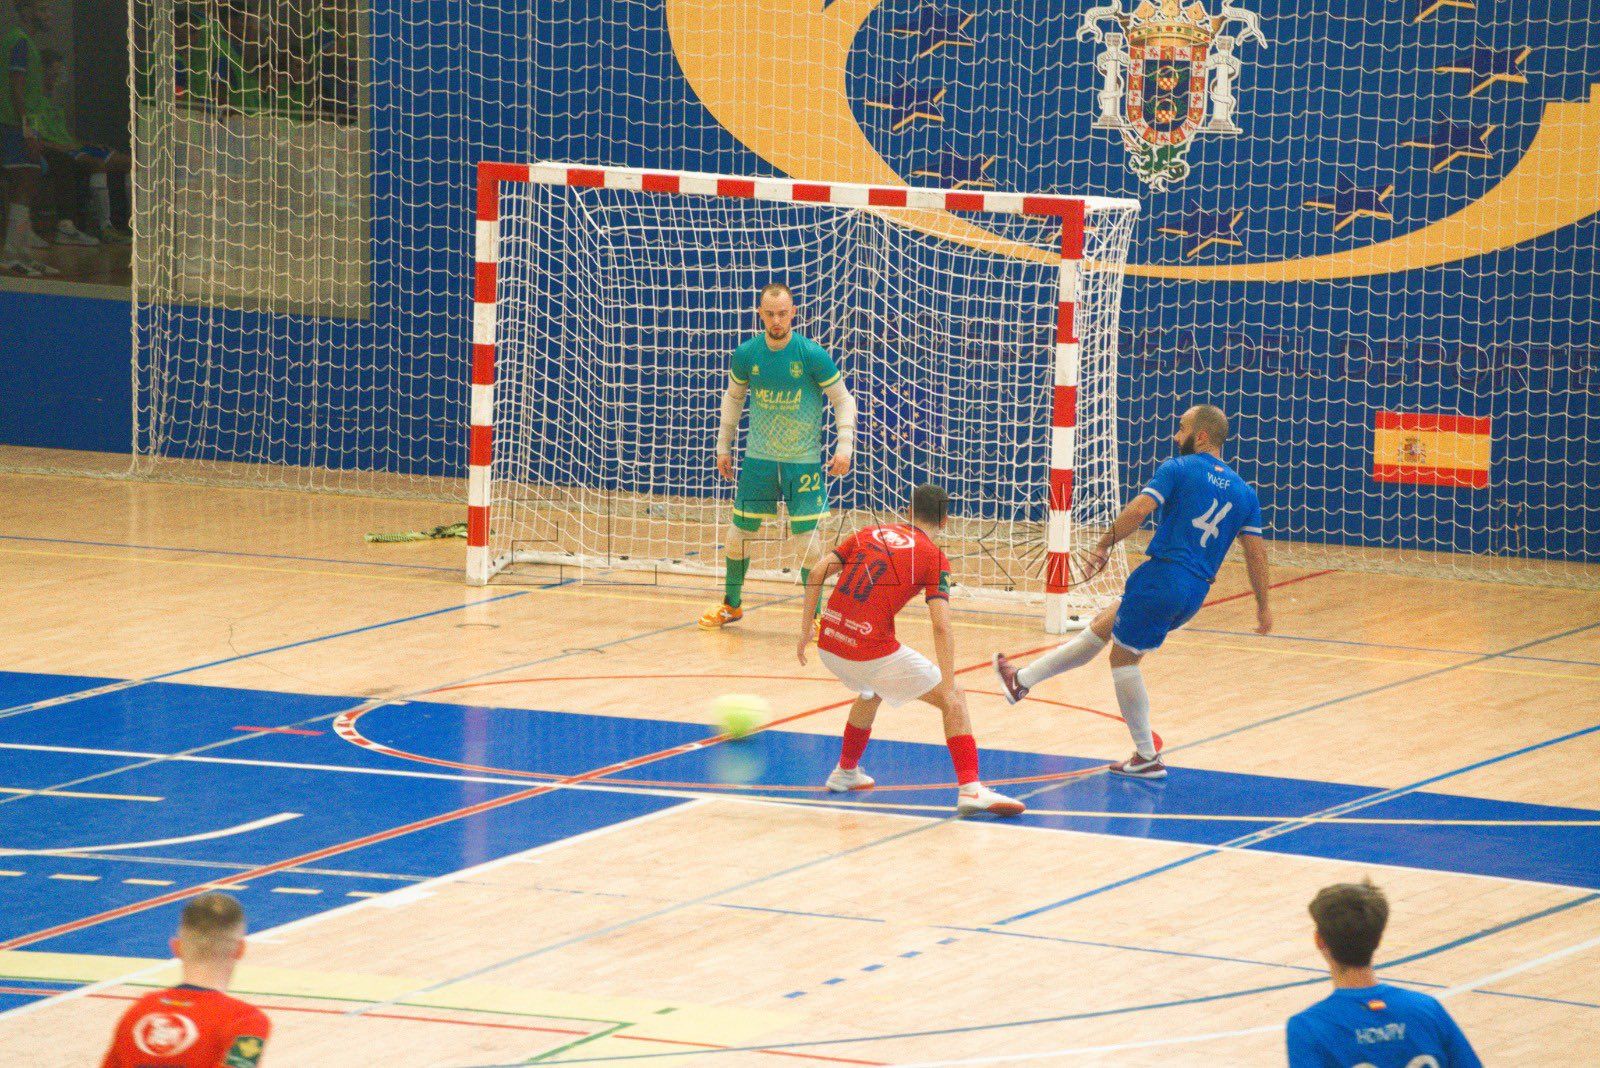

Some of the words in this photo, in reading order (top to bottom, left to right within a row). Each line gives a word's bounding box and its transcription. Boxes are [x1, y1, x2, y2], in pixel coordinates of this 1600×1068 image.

[1220, 331, 1322, 380] DEL
[755, 388, 802, 404] MELILLA
[797, 472, 821, 494] 22
[1191, 497, 1234, 548] 4
[839, 551, 889, 605] 10
